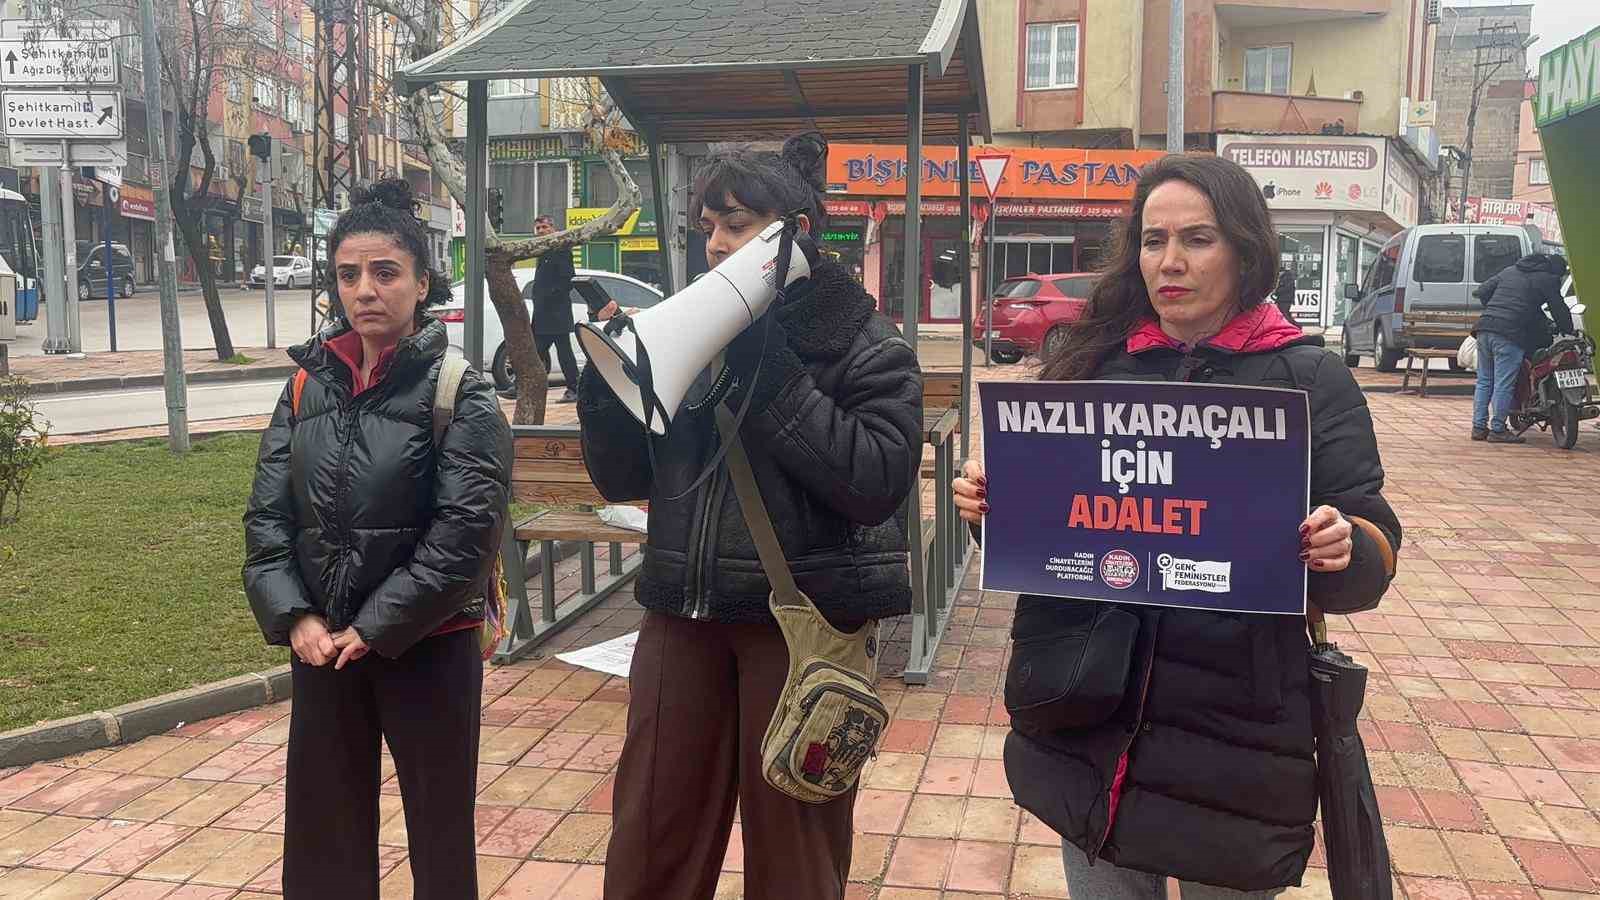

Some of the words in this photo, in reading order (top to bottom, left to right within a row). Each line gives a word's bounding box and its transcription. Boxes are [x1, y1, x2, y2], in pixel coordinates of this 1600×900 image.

[8, 101, 81, 113] Şehitkamil
[9, 117, 54, 128] Devlet
[56, 118, 94, 128] Hast.
[1231, 149, 1292, 166] TELEFON
[1295, 148, 1370, 168] HASTANESİ
[997, 400, 1096, 434] NAZLI
[1102, 402, 1287, 448] KARAÇALI
[1101, 439, 1173, 493] İÇİN
[1067, 494, 1208, 536] ADALET
[1174, 563, 1196, 572] GENÇ
[1174, 579, 1216, 588] FEDERASYONU
